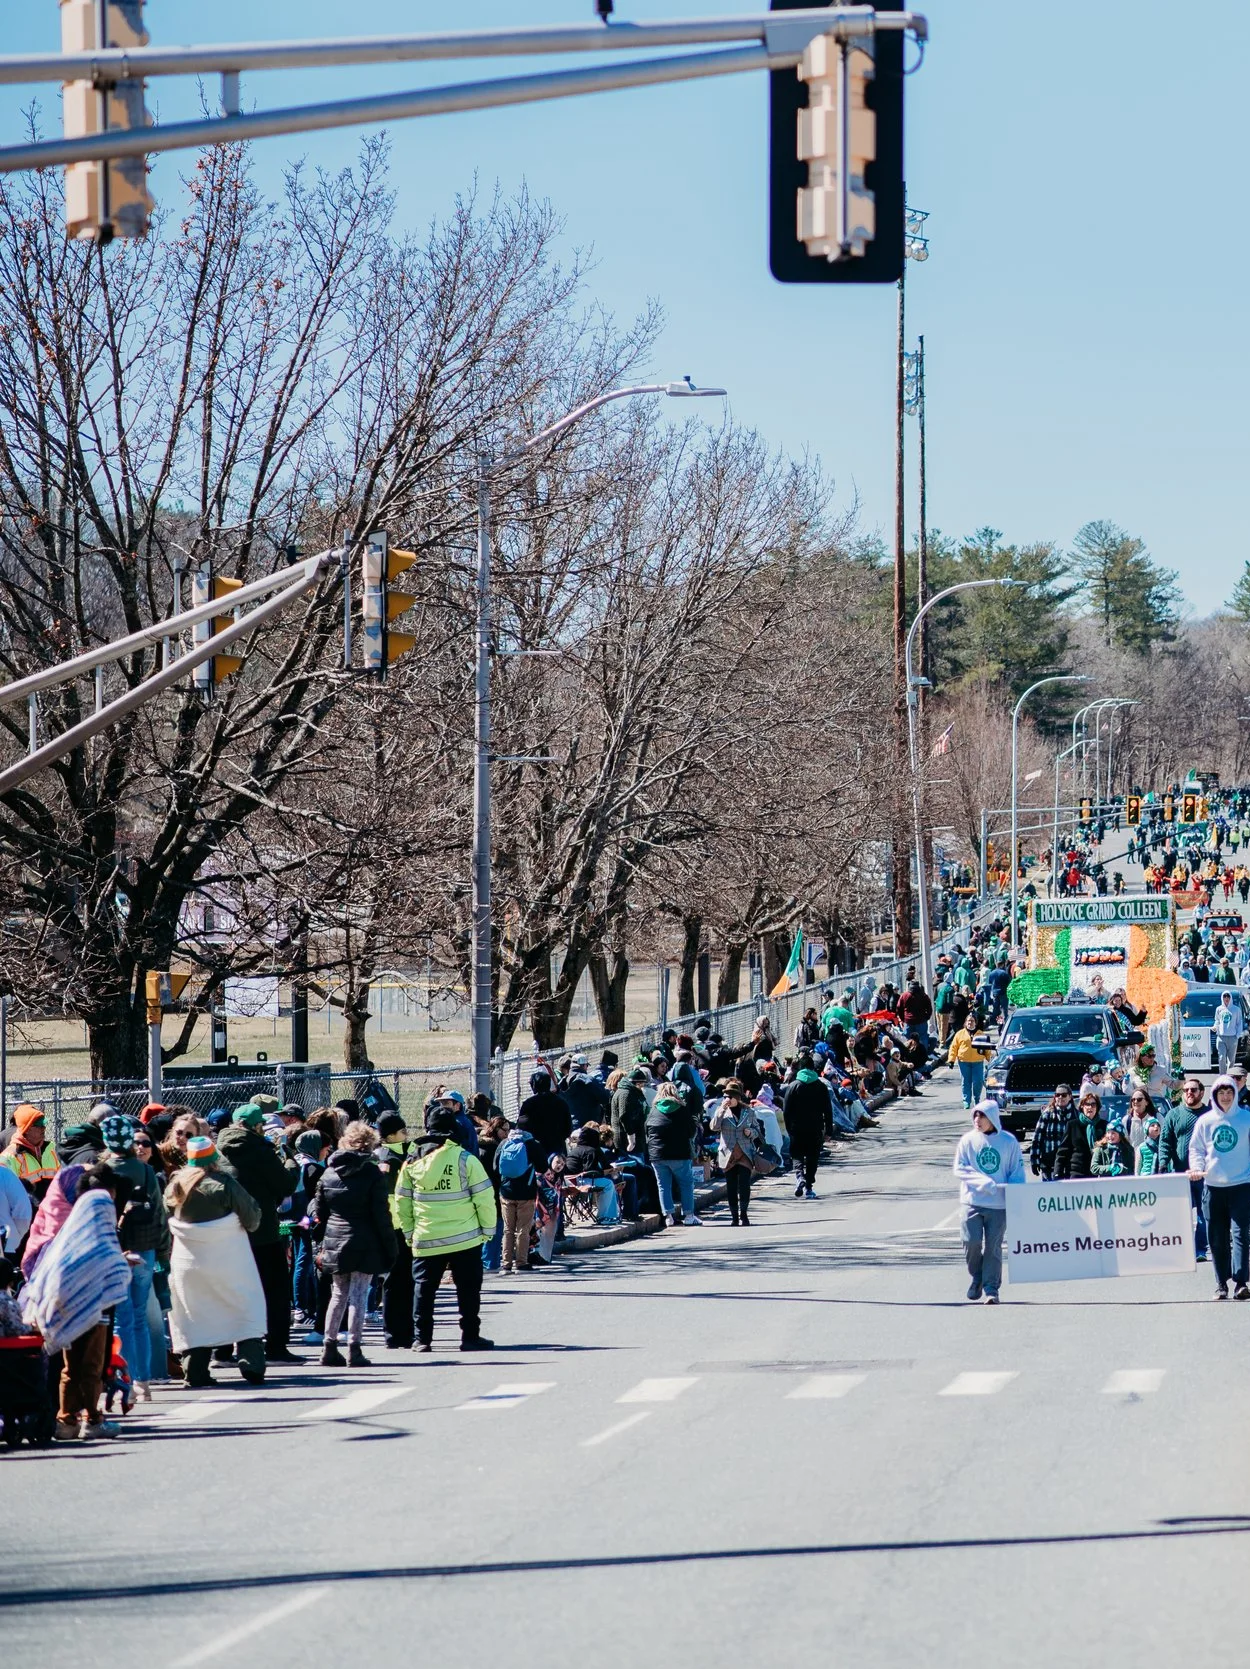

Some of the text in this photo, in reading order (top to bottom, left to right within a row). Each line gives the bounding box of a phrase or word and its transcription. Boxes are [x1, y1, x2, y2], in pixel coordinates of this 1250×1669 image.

[1040, 901, 1162, 922] HOLYOKE GRAND COLLEEN
[1182, 1033, 1202, 1041] AWARD
[1038, 1191, 1157, 1213] GALLIVAN AWARD
[1012, 1232, 1182, 1255] James Meenaghan
